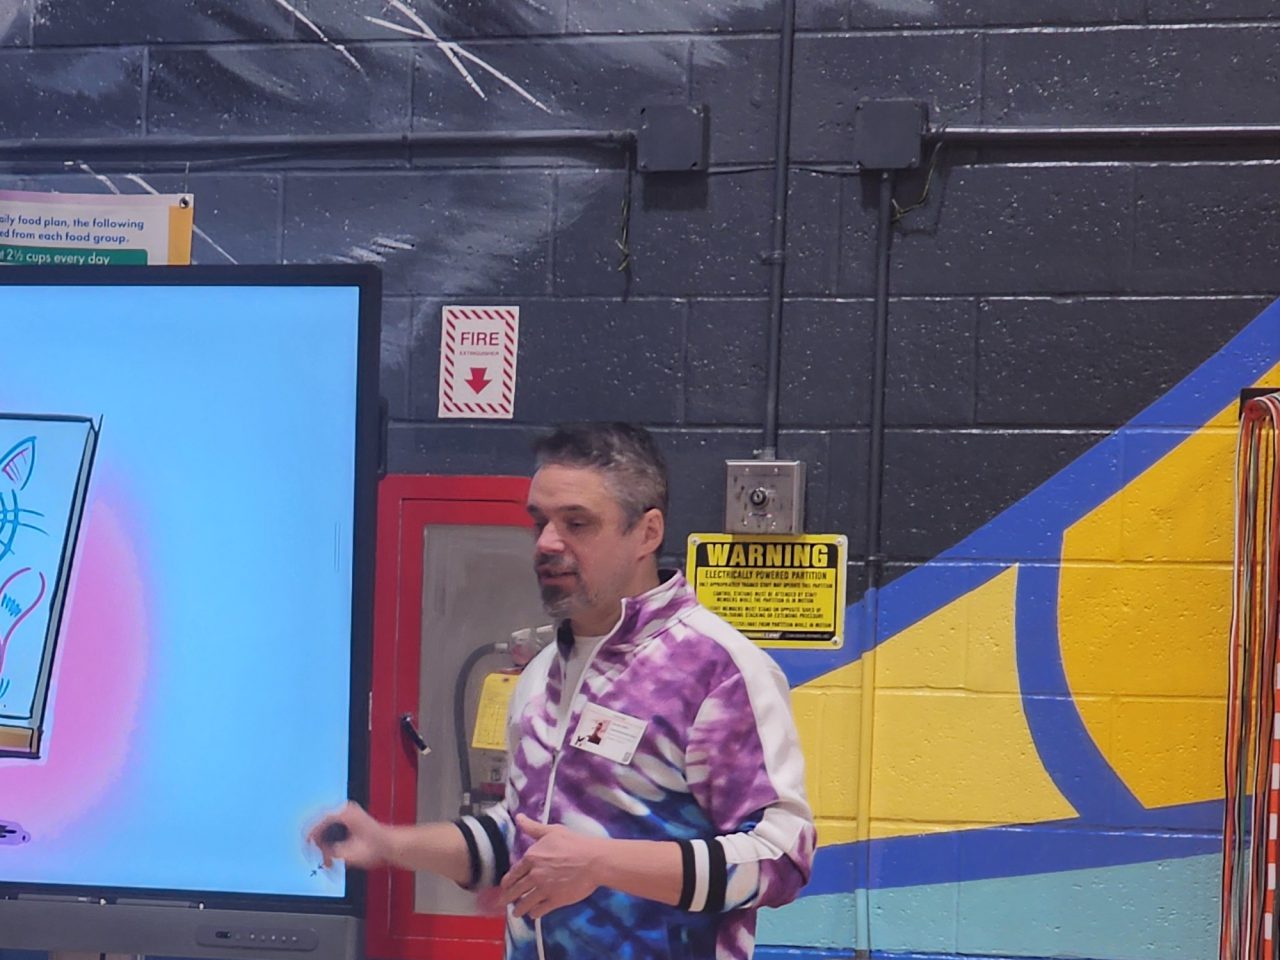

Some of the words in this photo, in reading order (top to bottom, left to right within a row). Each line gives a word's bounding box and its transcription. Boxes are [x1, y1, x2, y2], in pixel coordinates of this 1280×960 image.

[18, 214, 41, 226] food
[44, 217, 70, 229] plan,
[73, 218, 90, 228] the
[93, 218, 144, 231] following
[12, 229, 36, 240] from
[38, 231, 62, 241] each
[65, 232, 90, 242] food
[93, 234, 130, 245] group.
[26, 252, 51, 265] cups
[54, 253, 85, 265] every
[88, 251, 111, 265] day
[460, 331, 500, 346] FIRE
[707, 543, 828, 567] WARNING
[705, 570, 753, 579] ELECTRICALLY
[755, 570, 789, 579] POWERED
[792, 571, 827, 580] PARTITION
